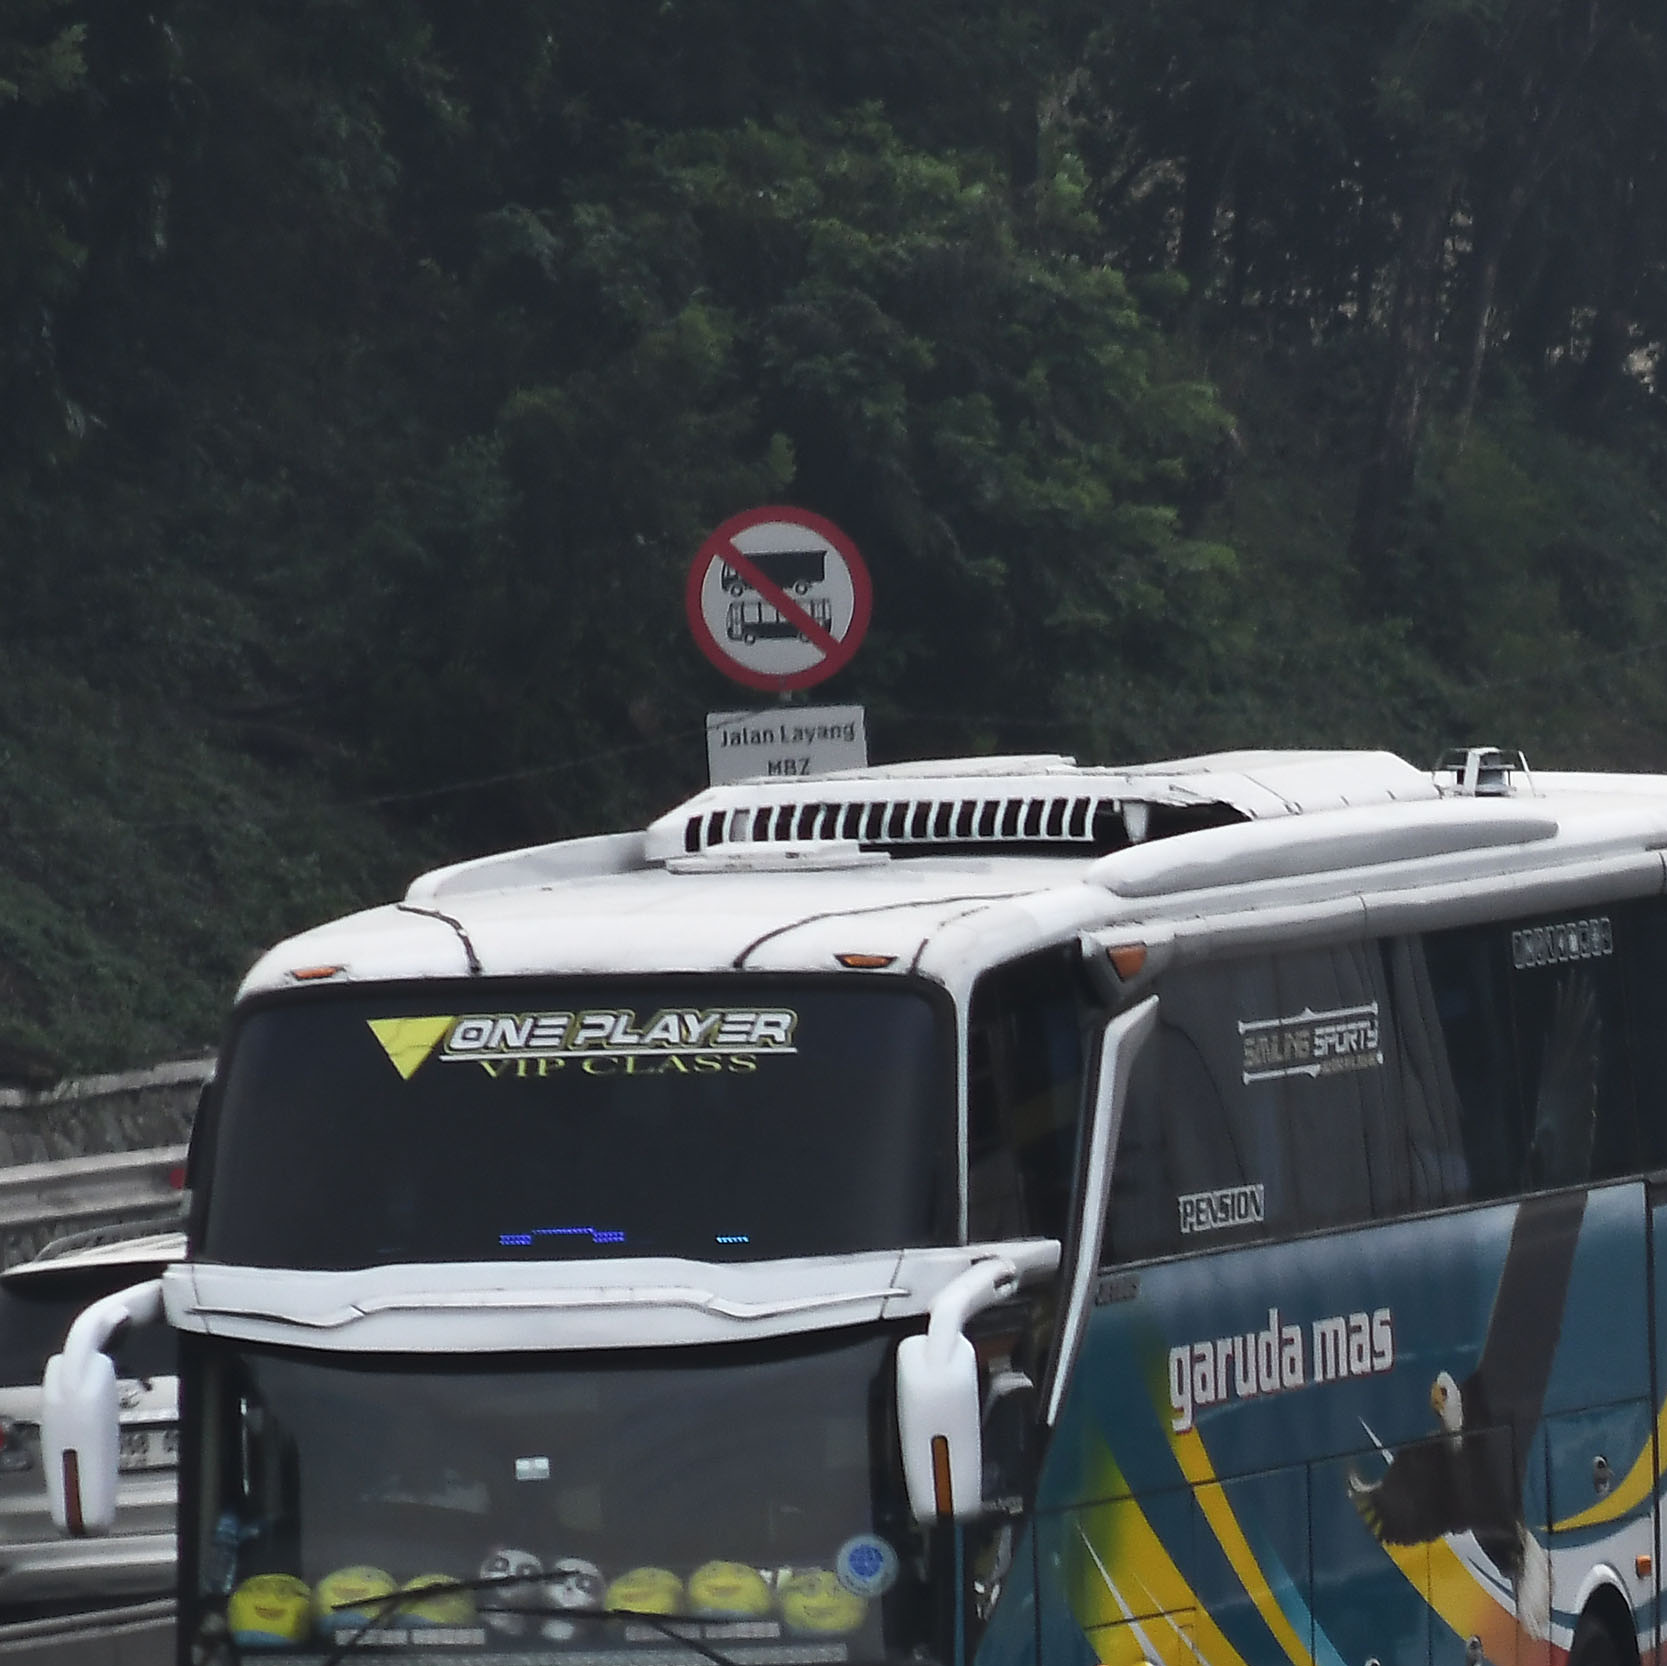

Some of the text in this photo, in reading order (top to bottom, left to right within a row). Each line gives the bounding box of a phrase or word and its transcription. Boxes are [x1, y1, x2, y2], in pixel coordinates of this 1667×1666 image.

[721, 722, 855, 747] Jalan Layang
[768, 757, 811, 776] MBZ
[448, 1009, 797, 1051] ONE PLAYER
[479, 1054, 757, 1077] VIP CLASS
[1179, 1184, 1264, 1233] PENSION
[1169, 1307, 1394, 1433] garuda mas
